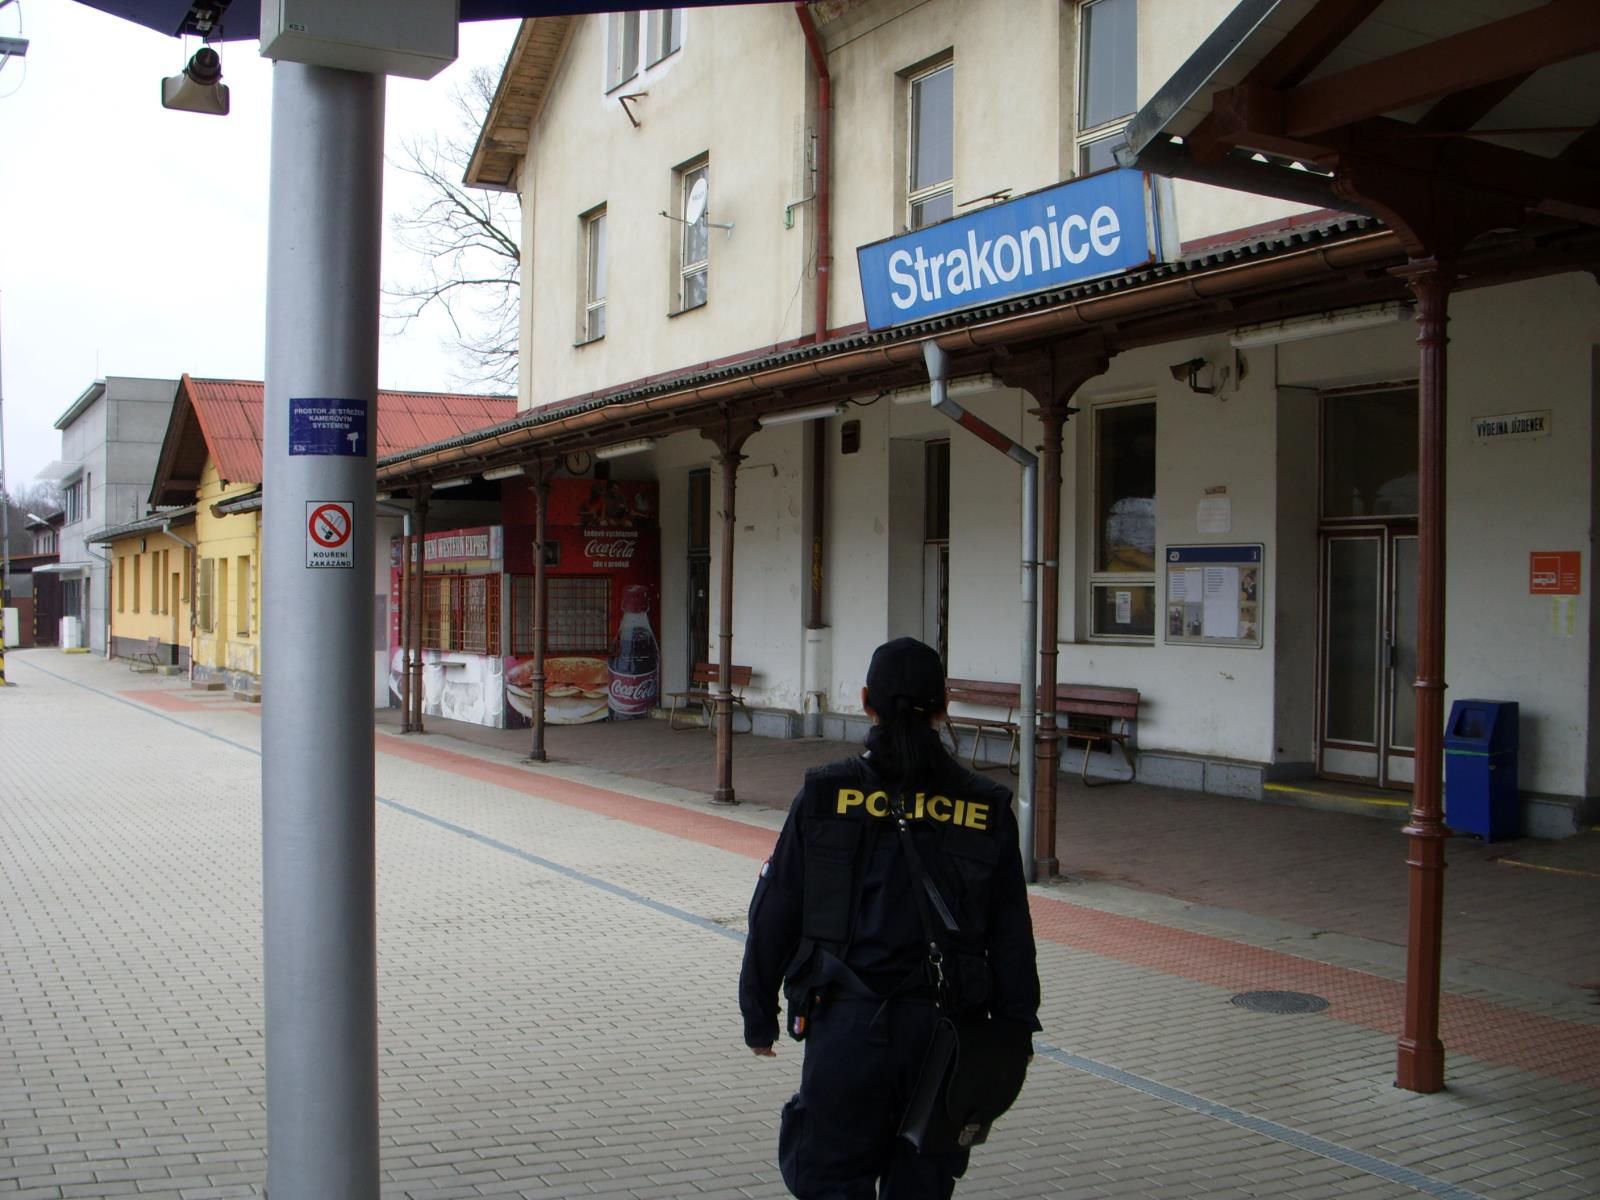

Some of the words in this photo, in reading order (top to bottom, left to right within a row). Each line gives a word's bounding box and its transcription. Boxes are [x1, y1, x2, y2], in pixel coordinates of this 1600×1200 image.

[888, 205, 1121, 310] Strakonice
[1477, 420, 1508, 437] VÝDEJNA
[1511, 417, 1544, 434] JÍZDENEK
[438, 536, 464, 559] WESTERN
[465, 534, 488, 557] EXPRES
[837, 788, 989, 831] POICIE
